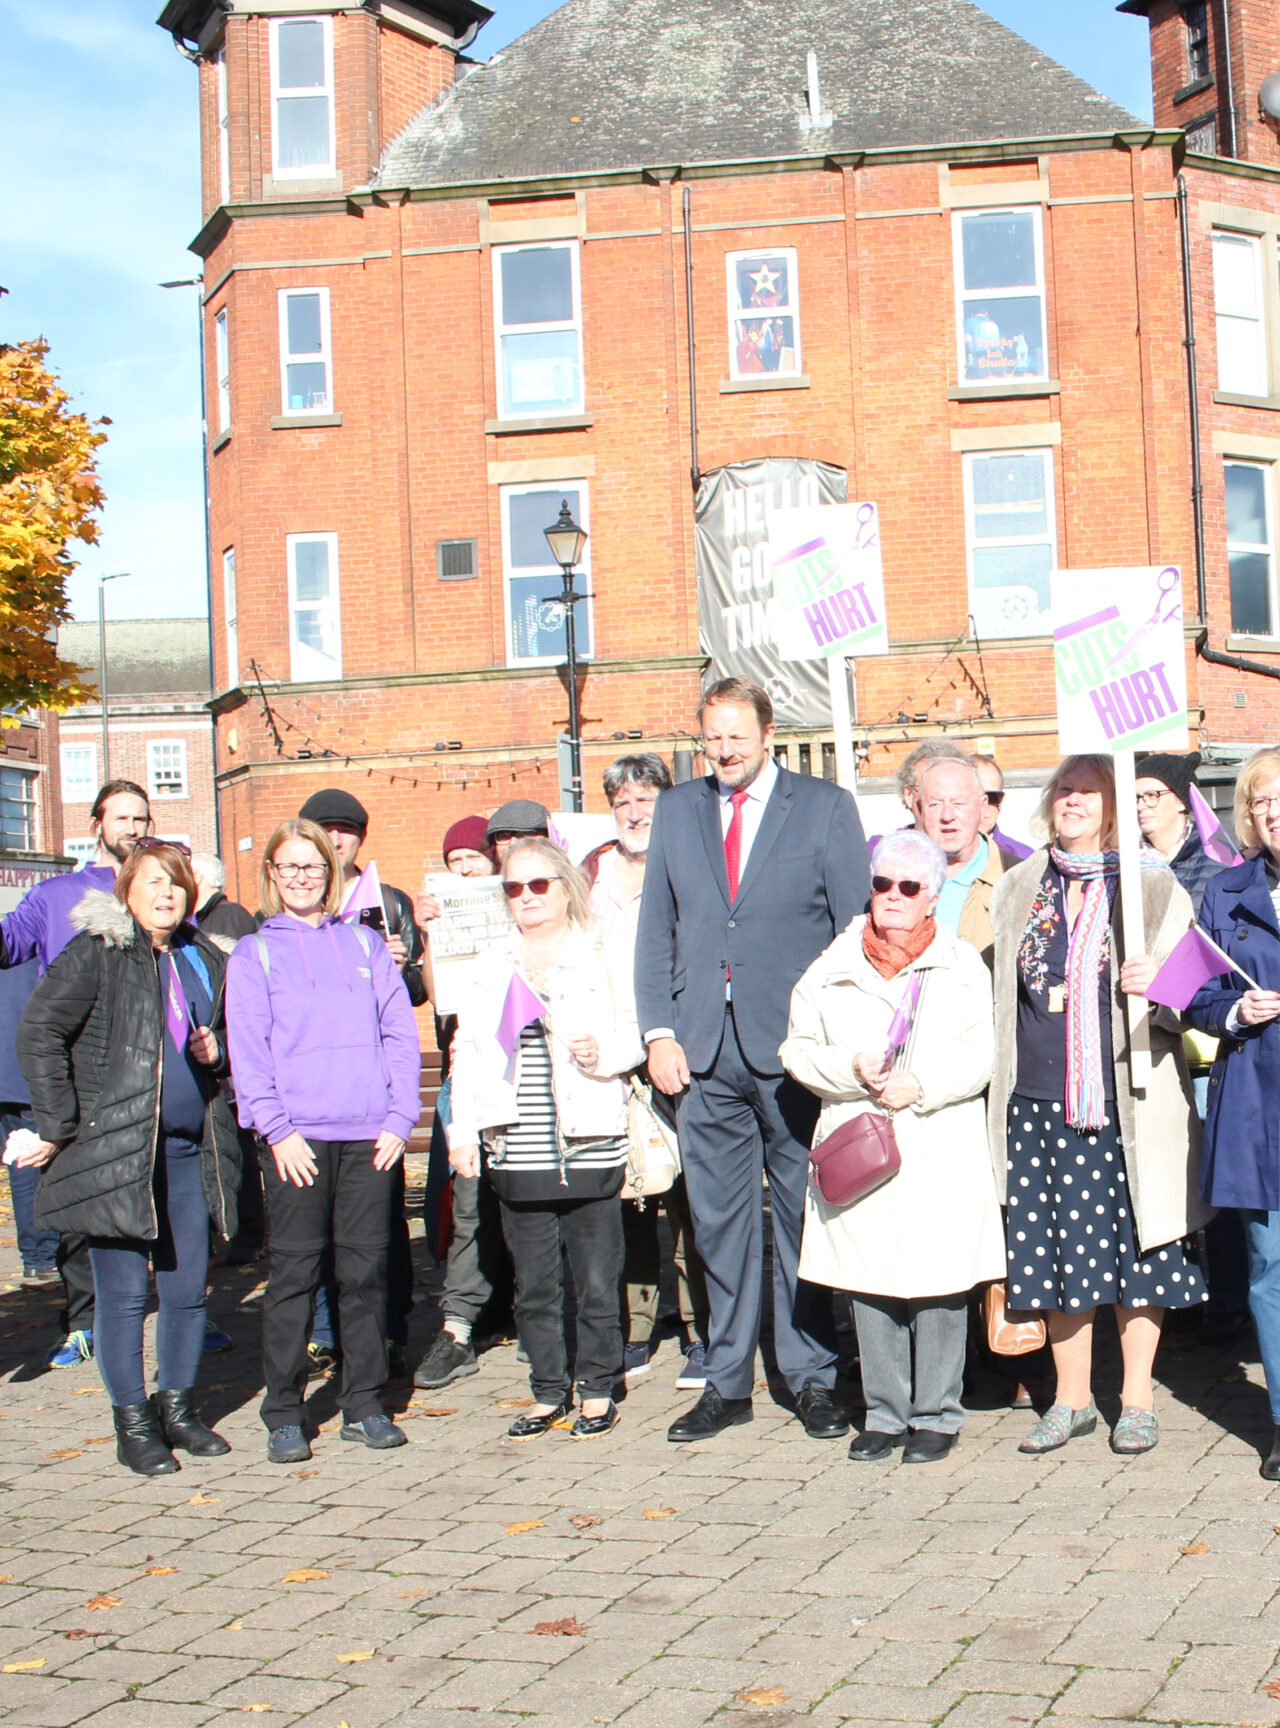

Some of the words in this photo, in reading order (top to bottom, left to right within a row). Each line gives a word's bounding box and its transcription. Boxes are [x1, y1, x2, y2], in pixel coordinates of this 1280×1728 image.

[978, 357, 1016, 368] Studio
[731, 541, 773, 593] GO
[802, 581, 878, 647] HURT
[1054, 620, 1140, 697] CUTS
[1089, 661, 1179, 739] HURT
